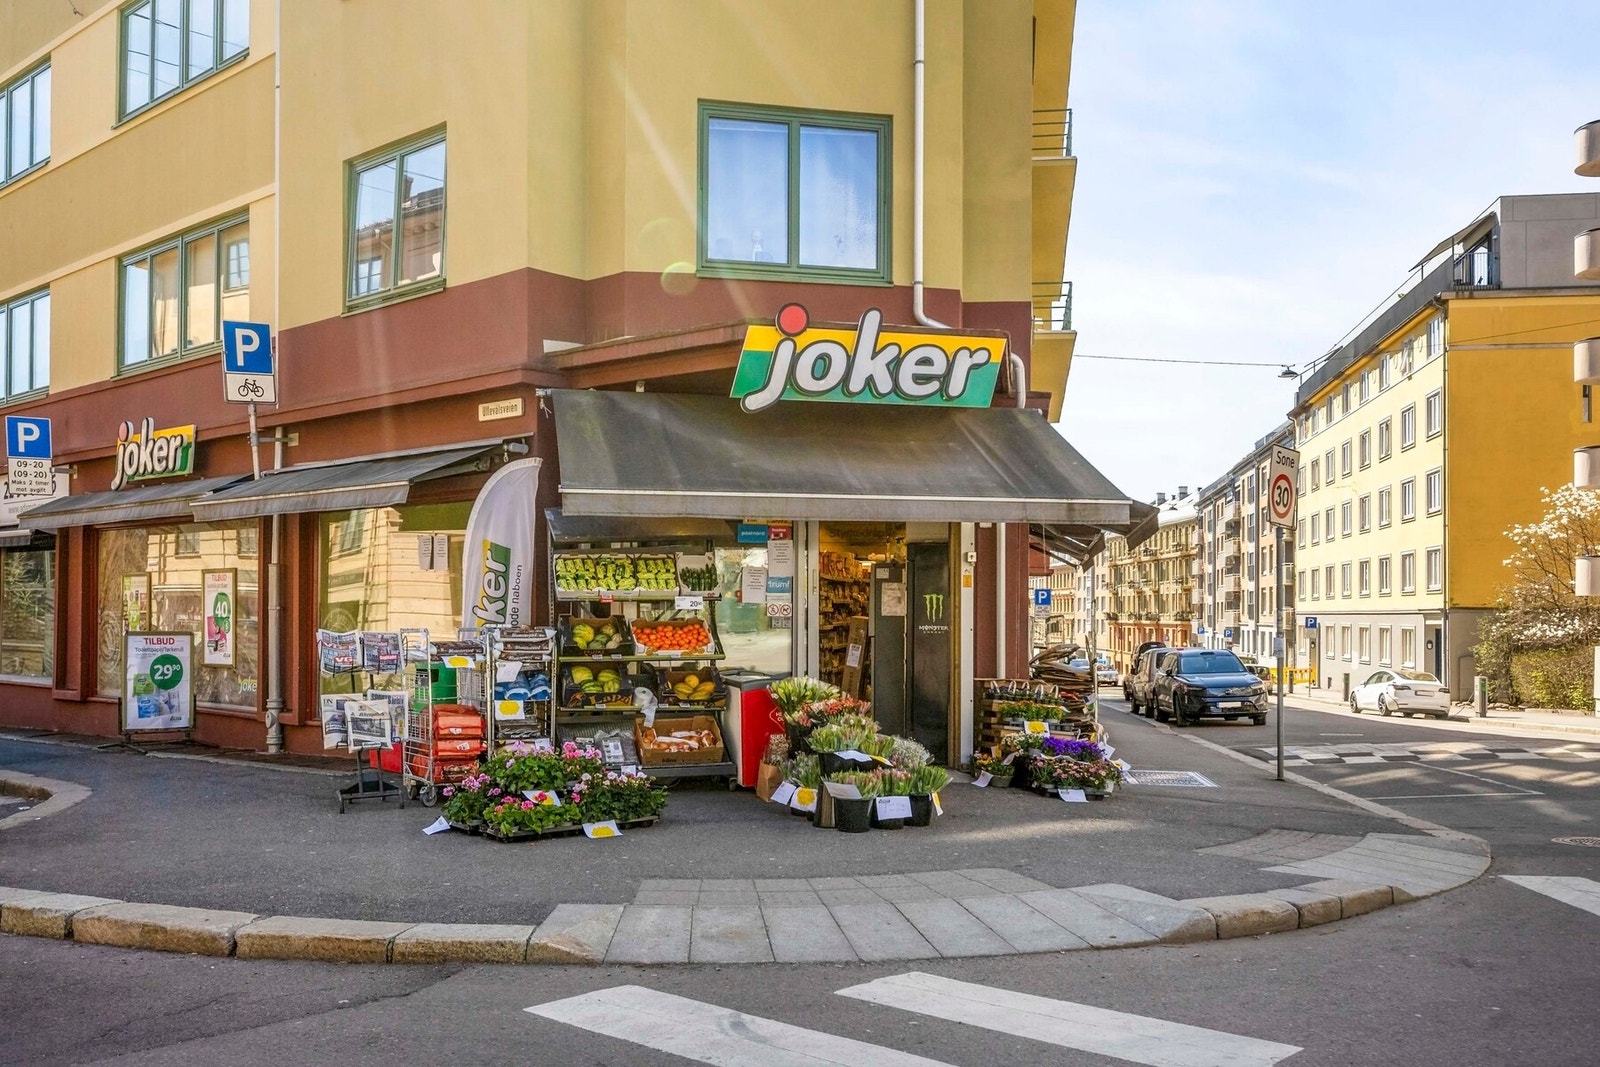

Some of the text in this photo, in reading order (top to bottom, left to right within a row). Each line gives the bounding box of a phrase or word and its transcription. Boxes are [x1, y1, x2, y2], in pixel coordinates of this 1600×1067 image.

[234, 327, 260, 366] P
[740, 303, 991, 413] joker
[17, 422, 40, 453] P
[111, 417, 188, 491] joker
[1276, 451, 1295, 468] Sone
[29, 486, 46, 494] avgift
[1275, 485, 1289, 508] 30
[472, 549, 508, 625] ker
[510, 565, 523, 629] ode naboen
[1038, 590, 1048, 604] P
[215, 601, 228, 618] 40
[1307, 618, 1315, 628] P
[143, 637, 175, 646] TILBUD
[239, 676, 257, 694] joke
